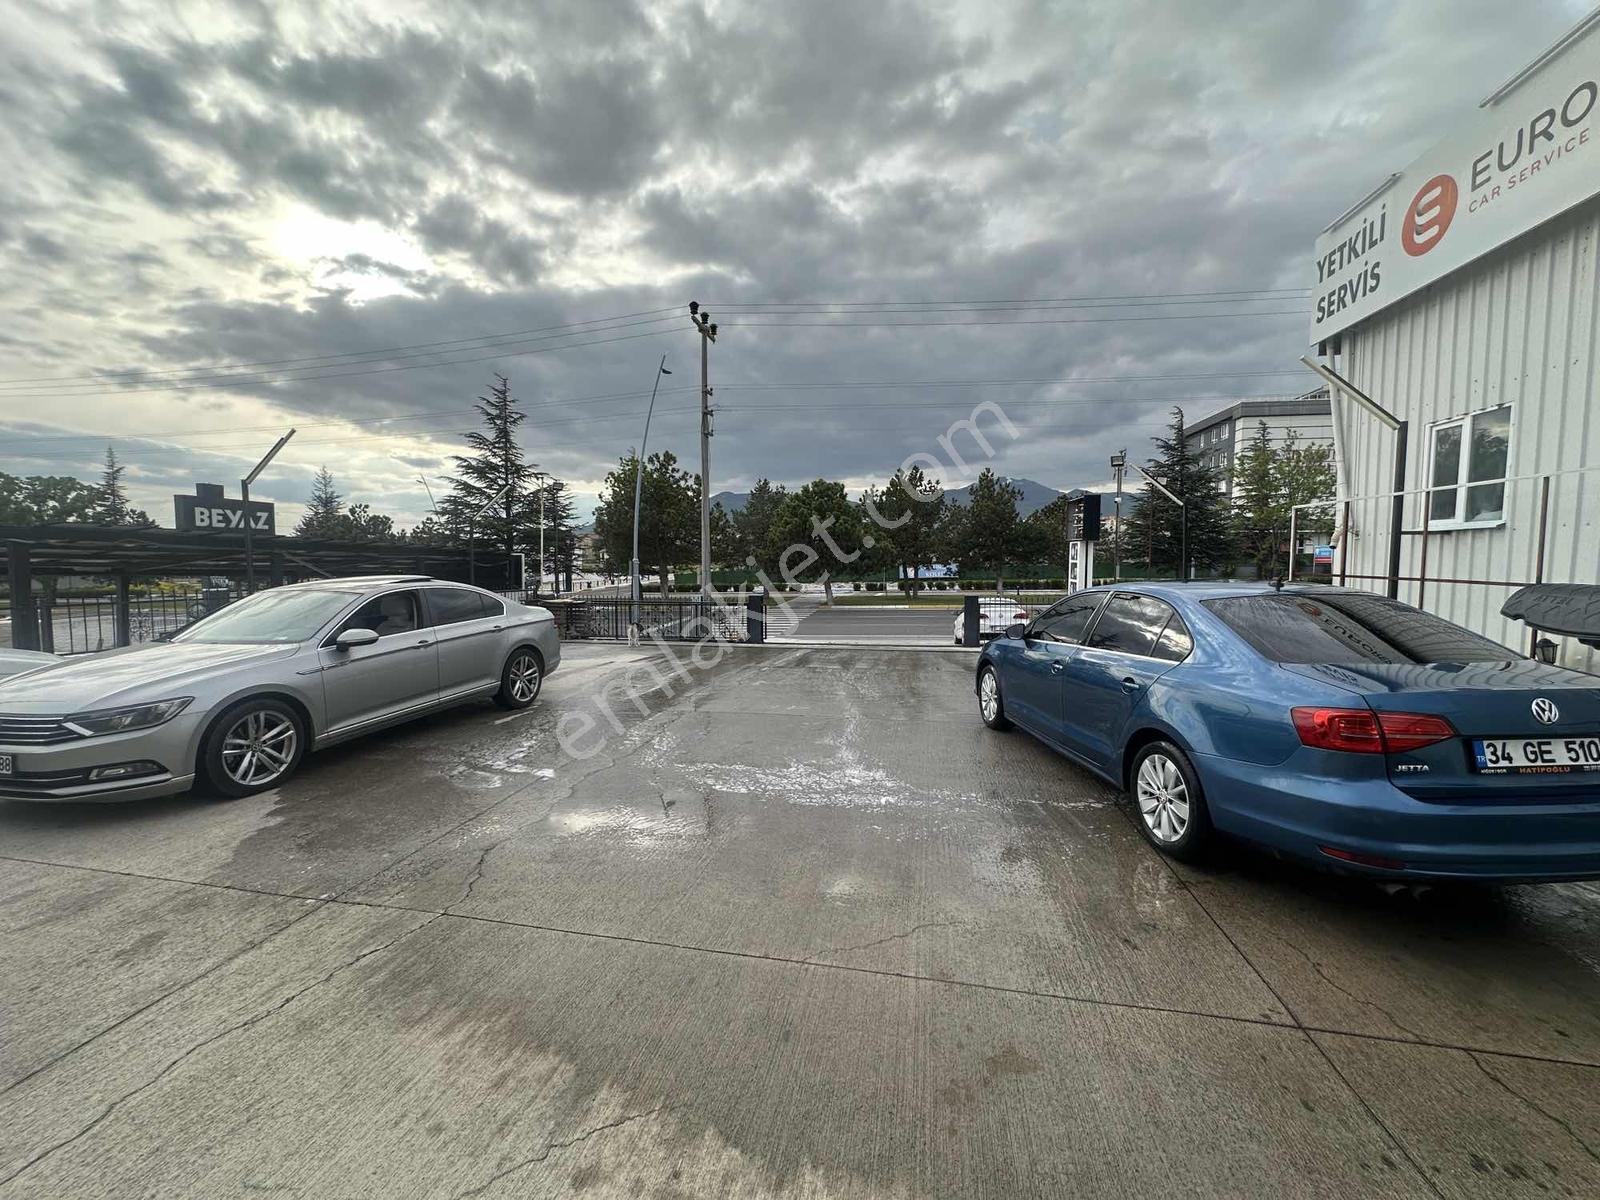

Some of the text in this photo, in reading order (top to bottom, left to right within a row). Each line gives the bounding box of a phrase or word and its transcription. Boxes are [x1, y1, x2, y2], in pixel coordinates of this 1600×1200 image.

[1468, 127, 1590, 213] CAR SERVICE
[1470, 81, 1598, 192] EURO
[1316, 204, 1387, 284] YETKİLİ
[1315, 260, 1381, 325] SERVİS
[1395, 764, 1430, 772] JETTA
[1485, 740, 1600, 764] 34 GE 510
